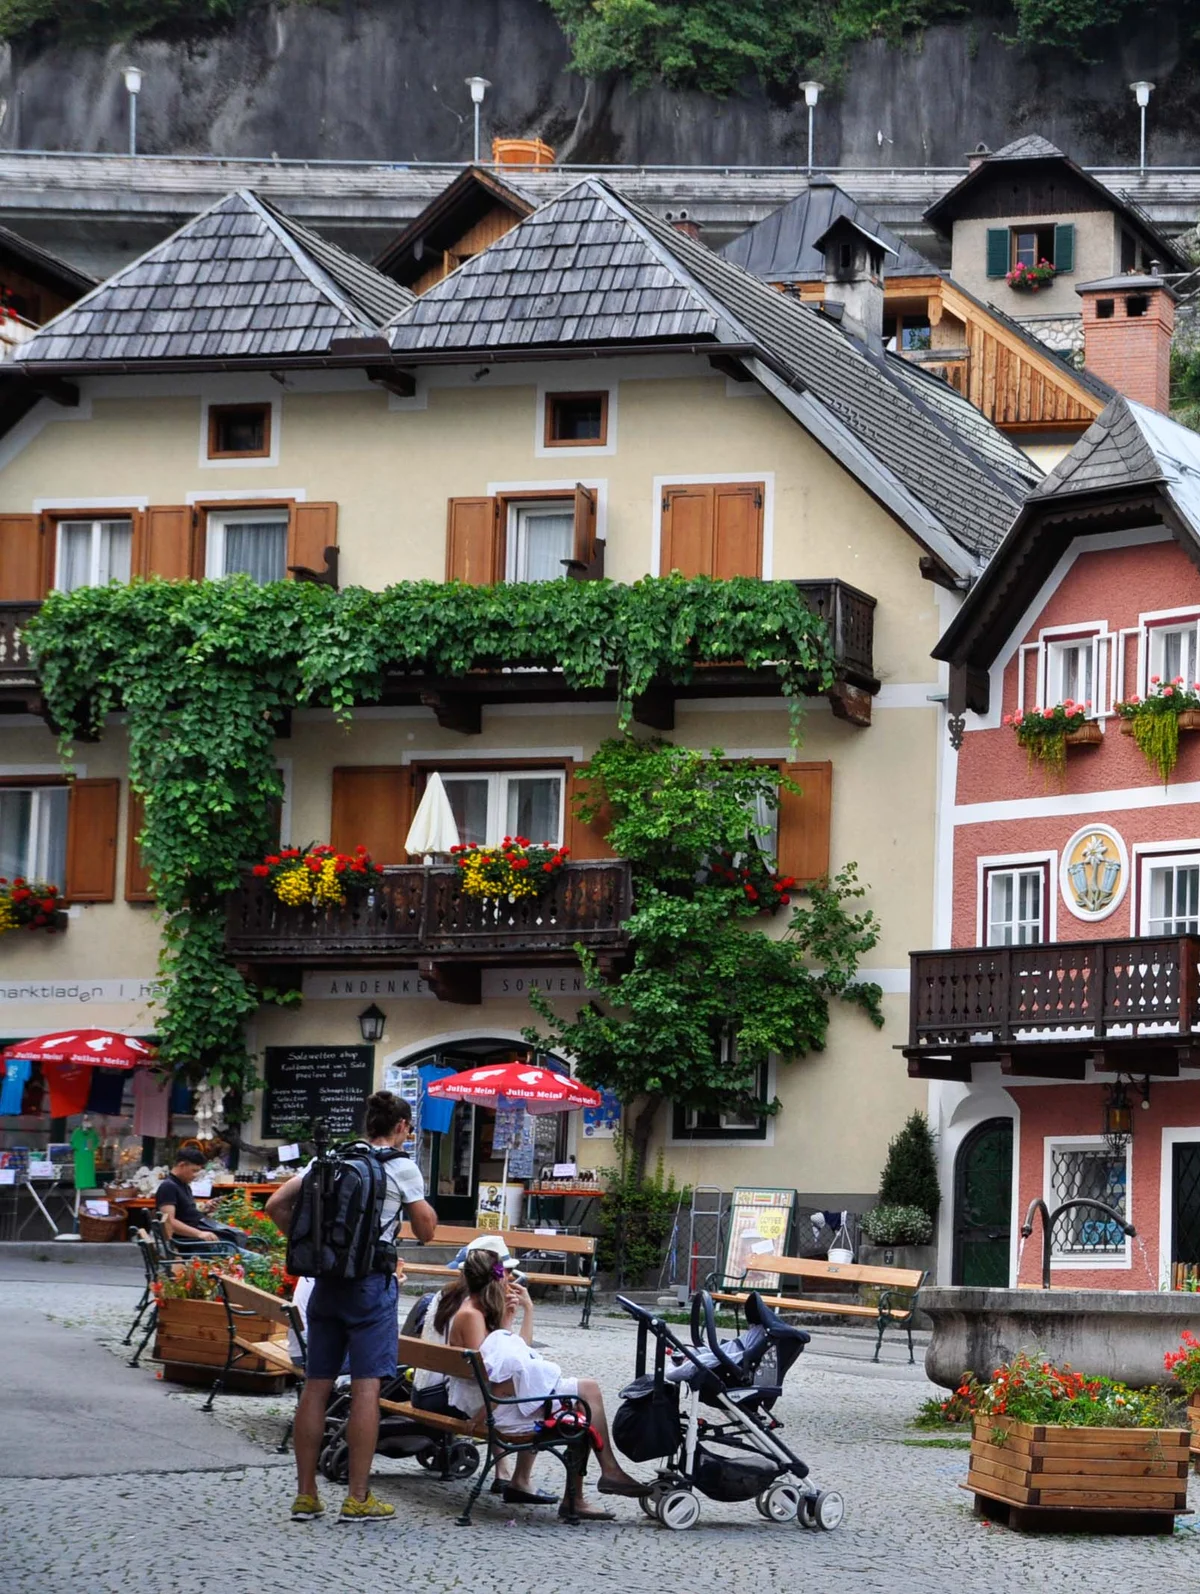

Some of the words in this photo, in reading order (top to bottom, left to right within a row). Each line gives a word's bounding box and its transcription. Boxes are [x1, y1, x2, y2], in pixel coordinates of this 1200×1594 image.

[330, 980, 423, 993] ANDENKE
[70, 1053, 101, 1063] Julius
[103, 1056, 129, 1066] Meinl
[445, 1085, 472, 1094] Julius
[473, 1086, 496, 1095] Meinl
[506, 1088, 535, 1098] Julius
[536, 1091, 563, 1100] Meinl
